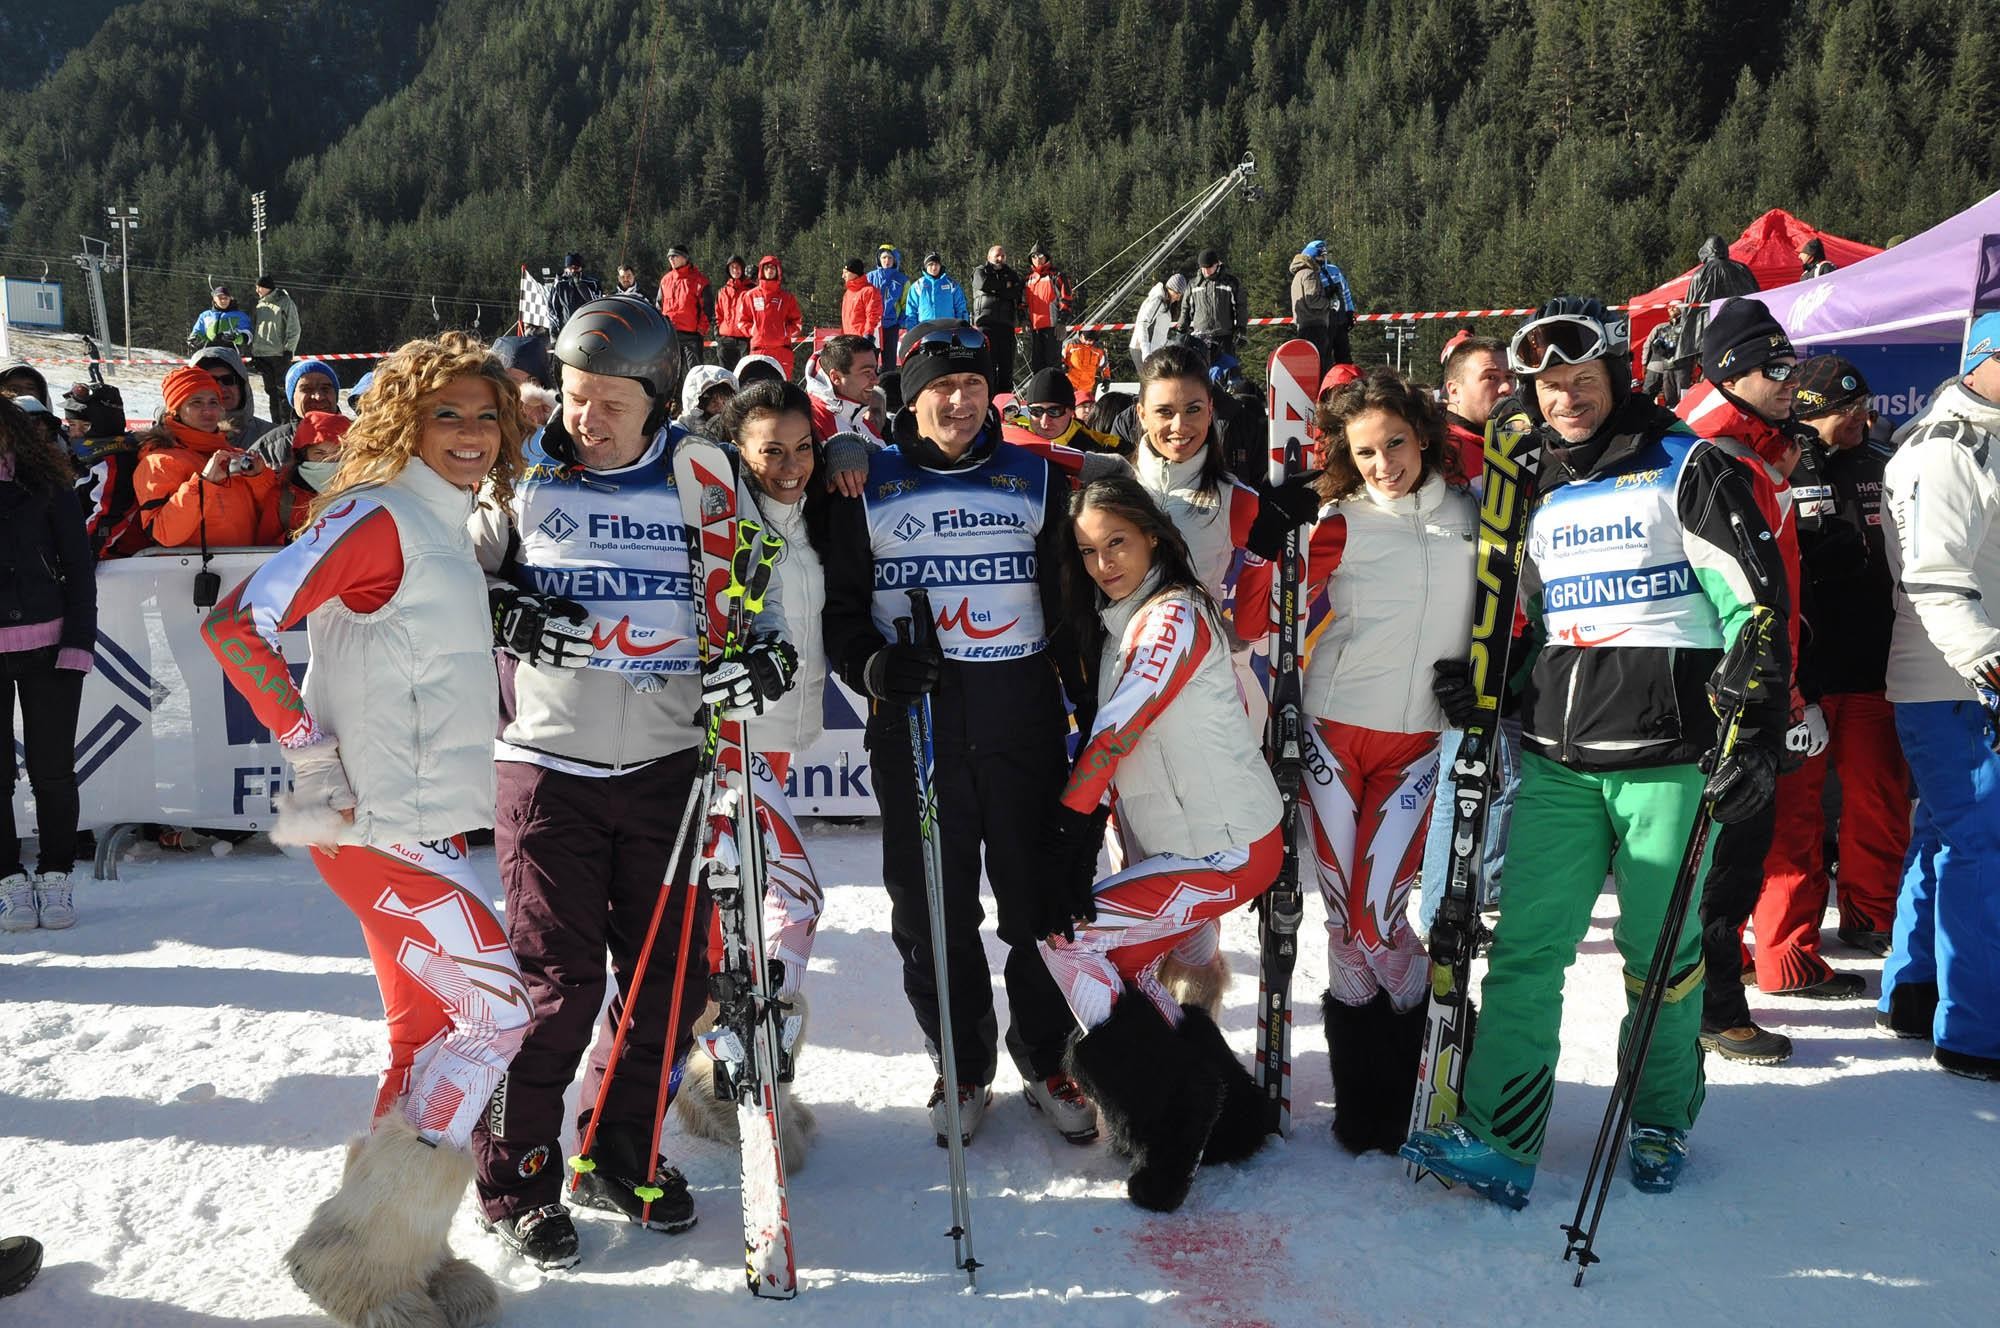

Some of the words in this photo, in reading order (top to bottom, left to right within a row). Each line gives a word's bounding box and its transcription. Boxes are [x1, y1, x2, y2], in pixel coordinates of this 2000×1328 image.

[1552, 516, 1646, 550] Fibank
[1551, 567, 1690, 609] GRÜNIGEN
[1142, 603, 1186, 683] HALTI
[233, 766, 290, 815] Fi
[389, 843, 425, 863] Audi
